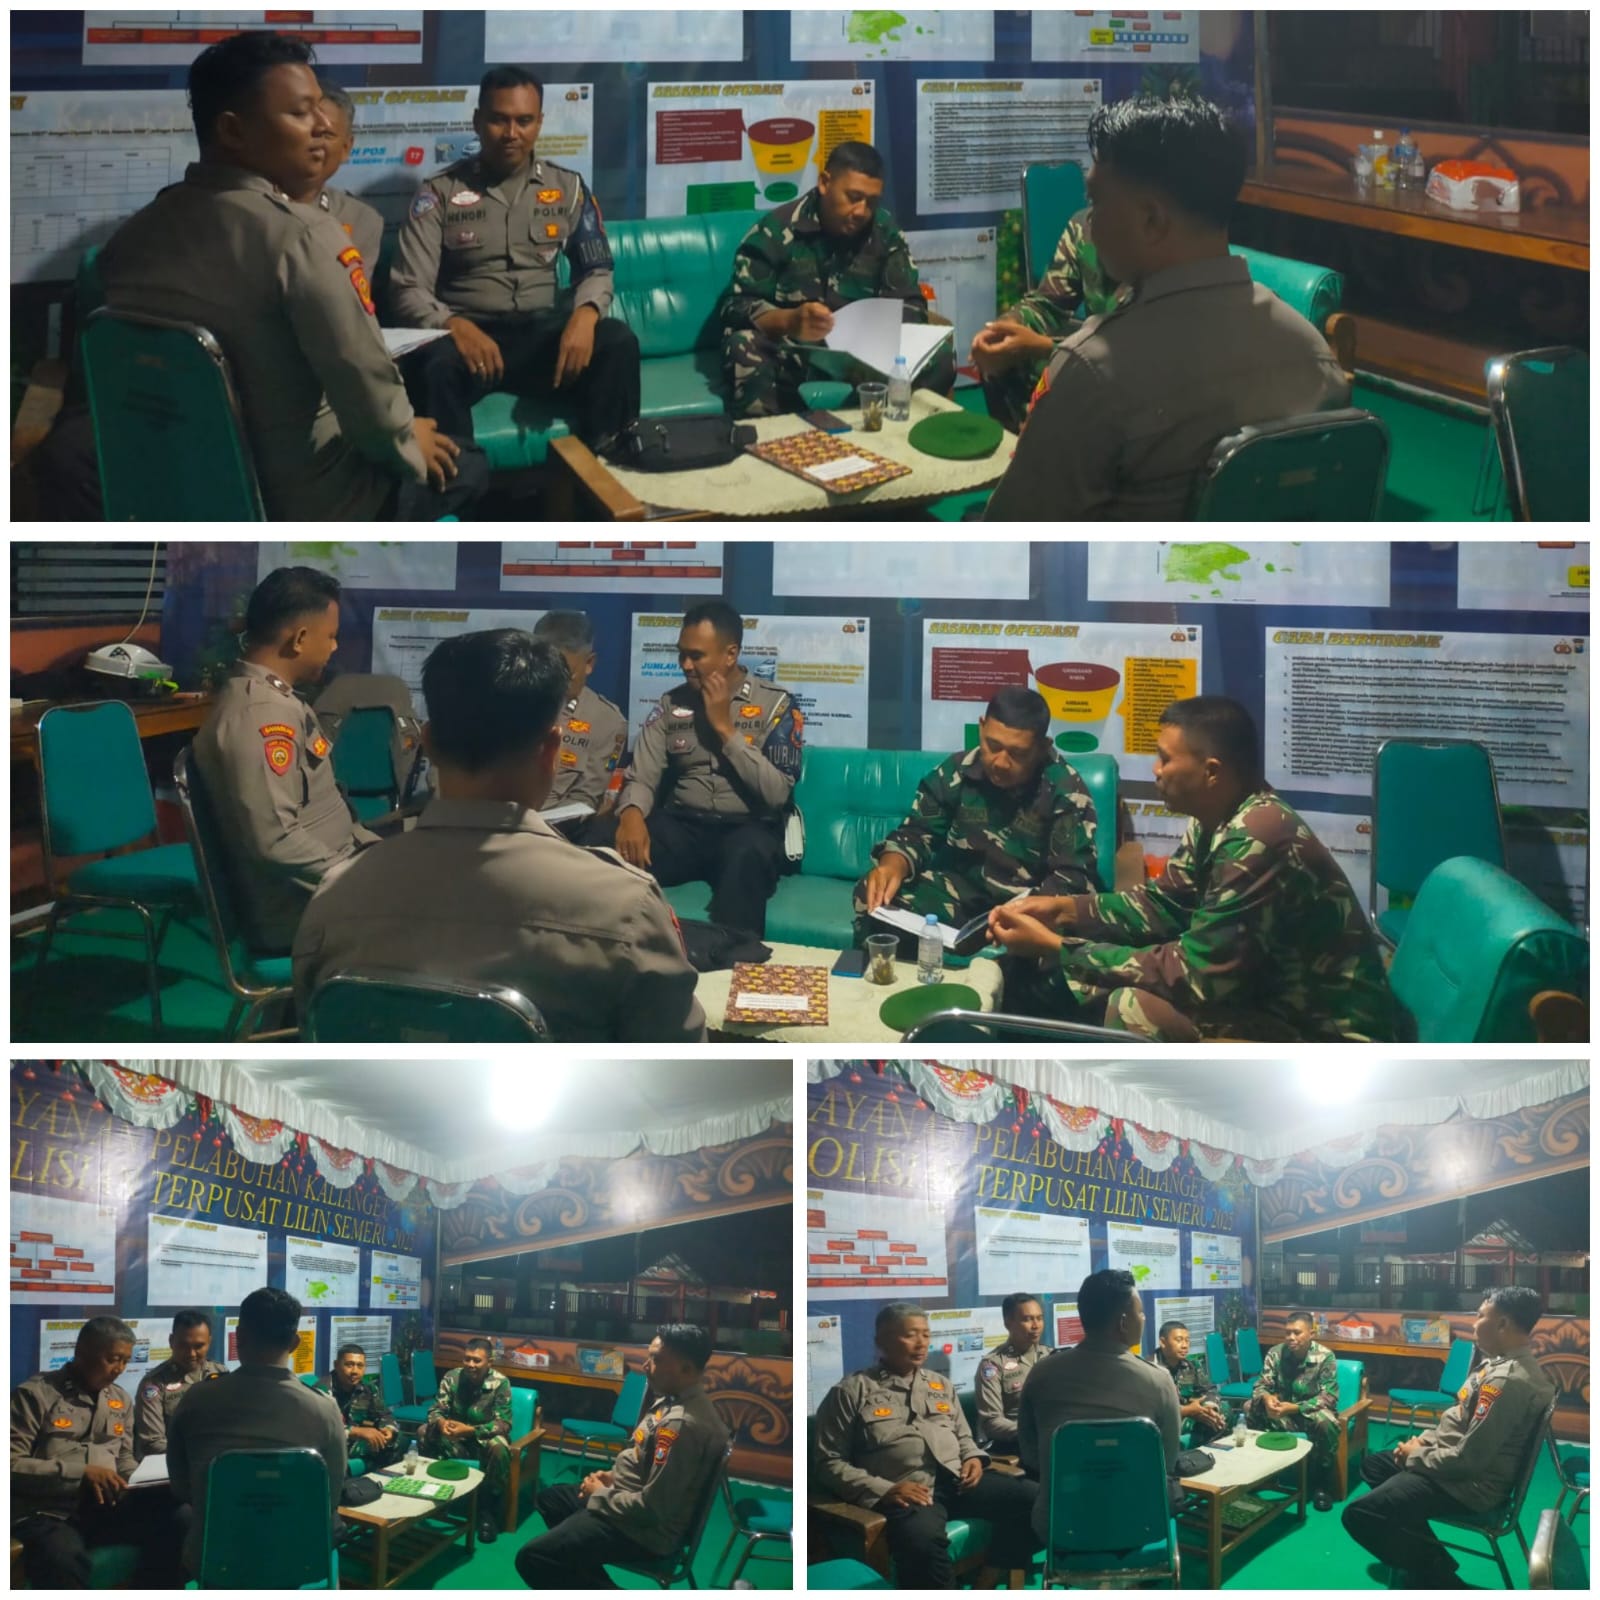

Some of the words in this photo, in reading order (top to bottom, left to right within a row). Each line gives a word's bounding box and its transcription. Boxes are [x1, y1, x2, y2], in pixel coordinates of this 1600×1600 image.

[533, 207, 568, 218] POLRI
[929, 622, 1003, 636] SASARAN
[1004, 623, 1080, 638] OPERASI
[1273, 631, 1325, 645] CARA
[734, 719, 765, 729] POLRI
[150, 1127, 300, 1196] PELABUHAN
[973, 1124, 1119, 1181] PELABUHAN
[151, 1170, 283, 1226] TERPUSAT
[282, 1199, 330, 1235] LILIN
[332, 1212, 388, 1247] SEMERU
[975, 1164, 1103, 1212] TERPUSAT
[1103, 1187, 1149, 1218] LILIN
[1152, 1195, 1208, 1227] SEMERU
